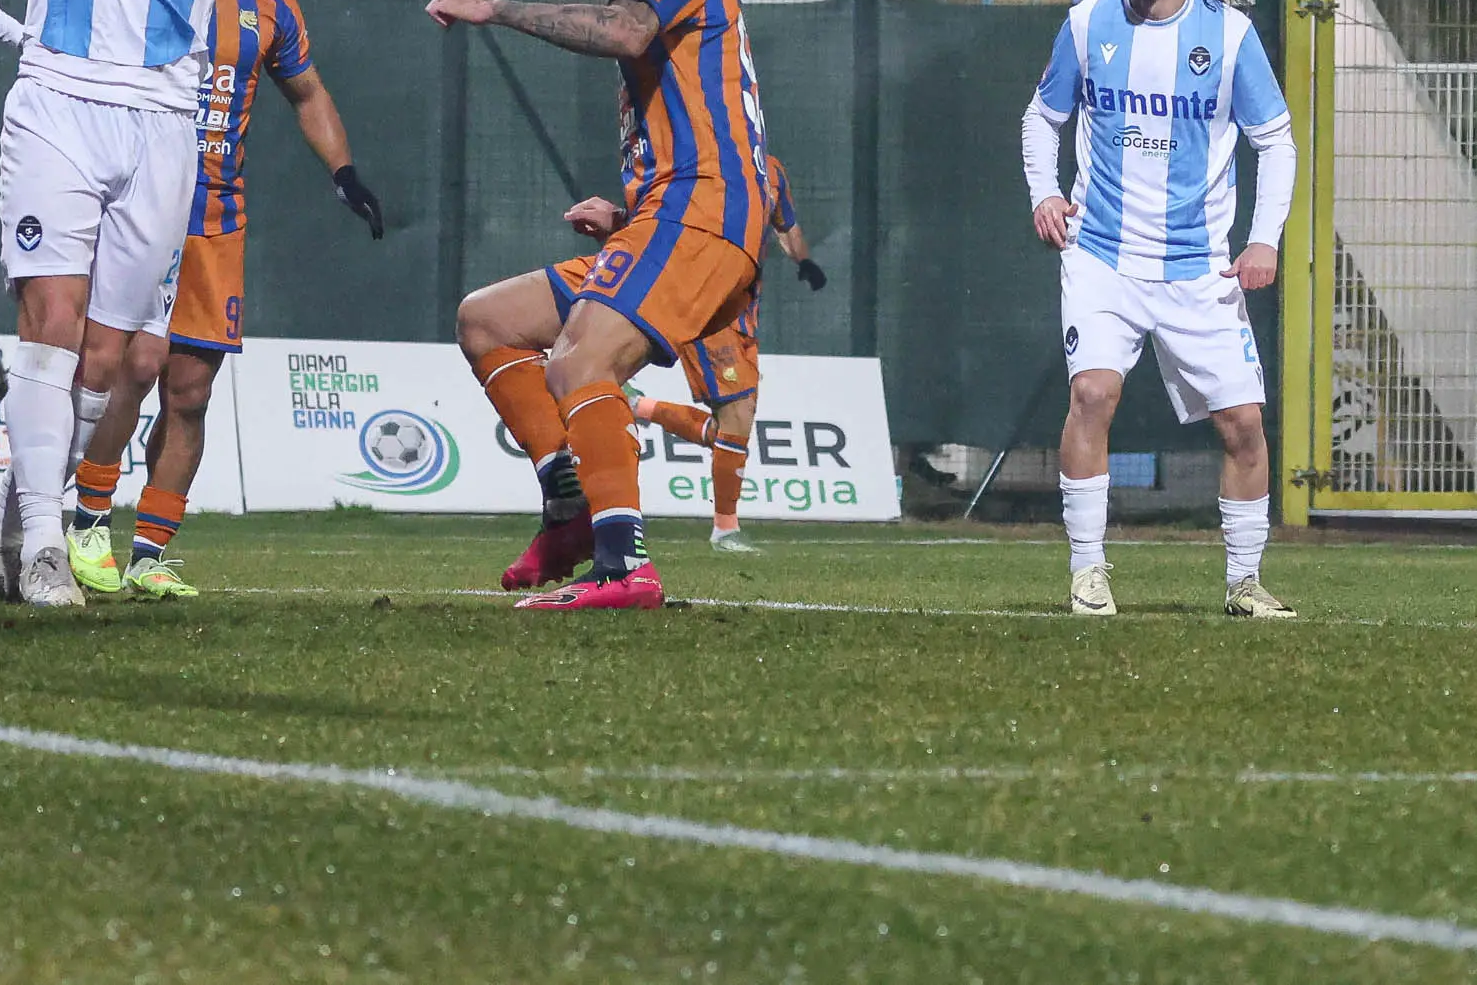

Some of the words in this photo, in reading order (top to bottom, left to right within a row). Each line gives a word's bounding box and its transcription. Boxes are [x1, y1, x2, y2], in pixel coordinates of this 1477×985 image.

[201, 62, 236, 93] 2a
[196, 92, 233, 105] OMPANY
[1085, 78, 1218, 120] Bamonte
[197, 139, 231, 155] arsh
[1112, 136, 1178, 151] COGESER
[288, 354, 347, 373] DIAMO
[289, 372, 379, 392] ENERGIA
[292, 391, 341, 410] ALLA
[293, 409, 356, 429] GIANA
